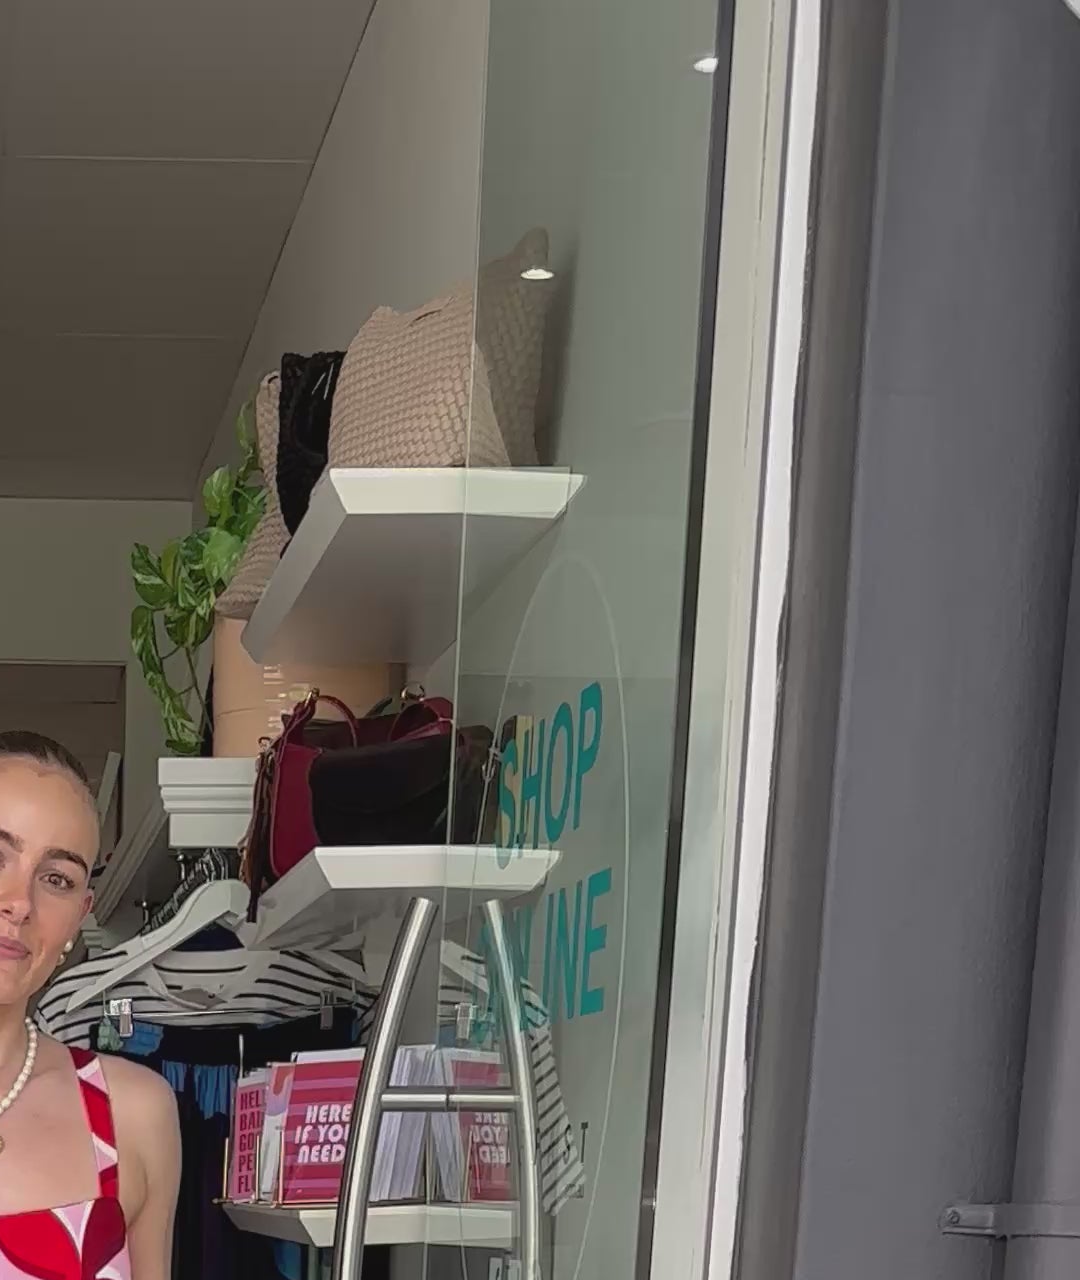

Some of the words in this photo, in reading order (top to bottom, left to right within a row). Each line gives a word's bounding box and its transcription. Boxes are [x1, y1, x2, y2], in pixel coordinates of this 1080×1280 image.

[495, 681, 604, 869] SHOP
[474, 868, 613, 1043] LINE
[295, 1125, 311, 1144] IF
[305, 1104, 352, 1124] HERE
